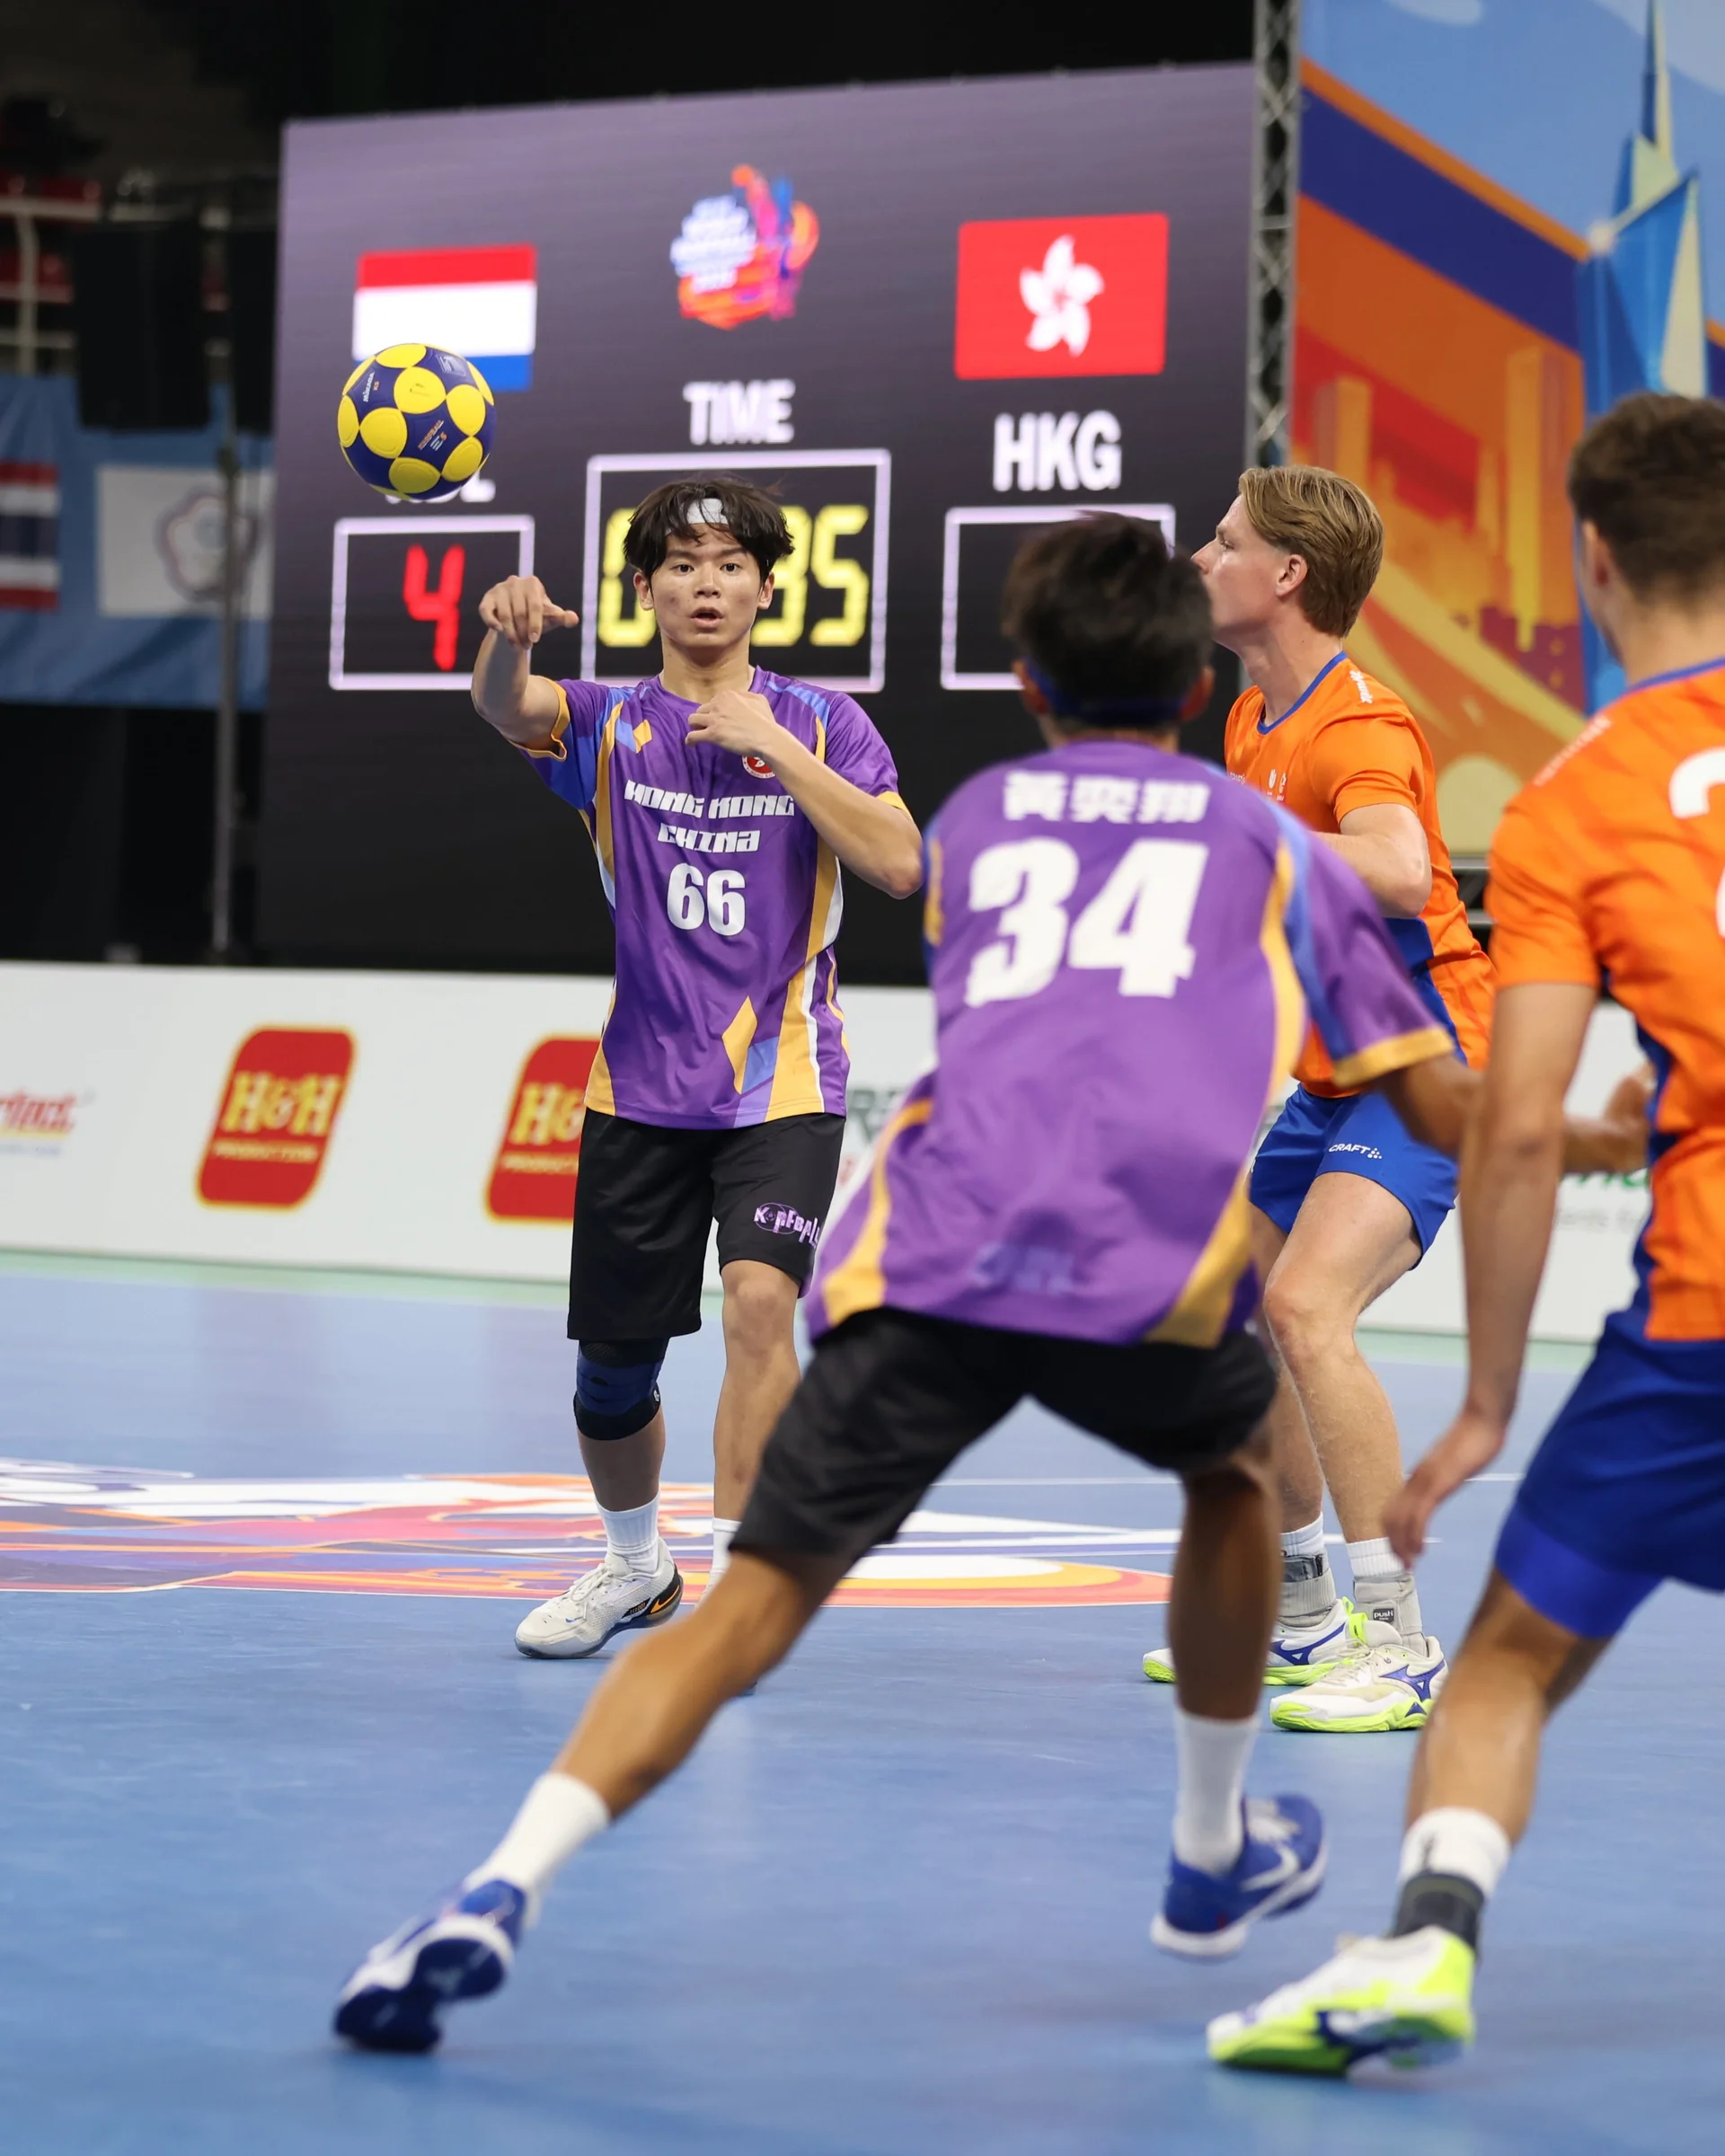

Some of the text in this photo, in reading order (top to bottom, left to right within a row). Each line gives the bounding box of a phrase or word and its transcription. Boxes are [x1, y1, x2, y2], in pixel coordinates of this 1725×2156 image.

[685, 381, 795, 445] TIME
[994, 411, 1122, 491] HKG
[403, 543, 464, 671] 4
[624, 779, 794, 818] HONG KONG
[658, 823, 760, 853] CHINA
[667, 863, 746, 936] 66
[965, 836, 1209, 1008] 34
[223, 1073, 340, 1136] H&H
[509, 1082, 586, 1144] H&
[1329, 1143, 1371, 1153] CRAFT
